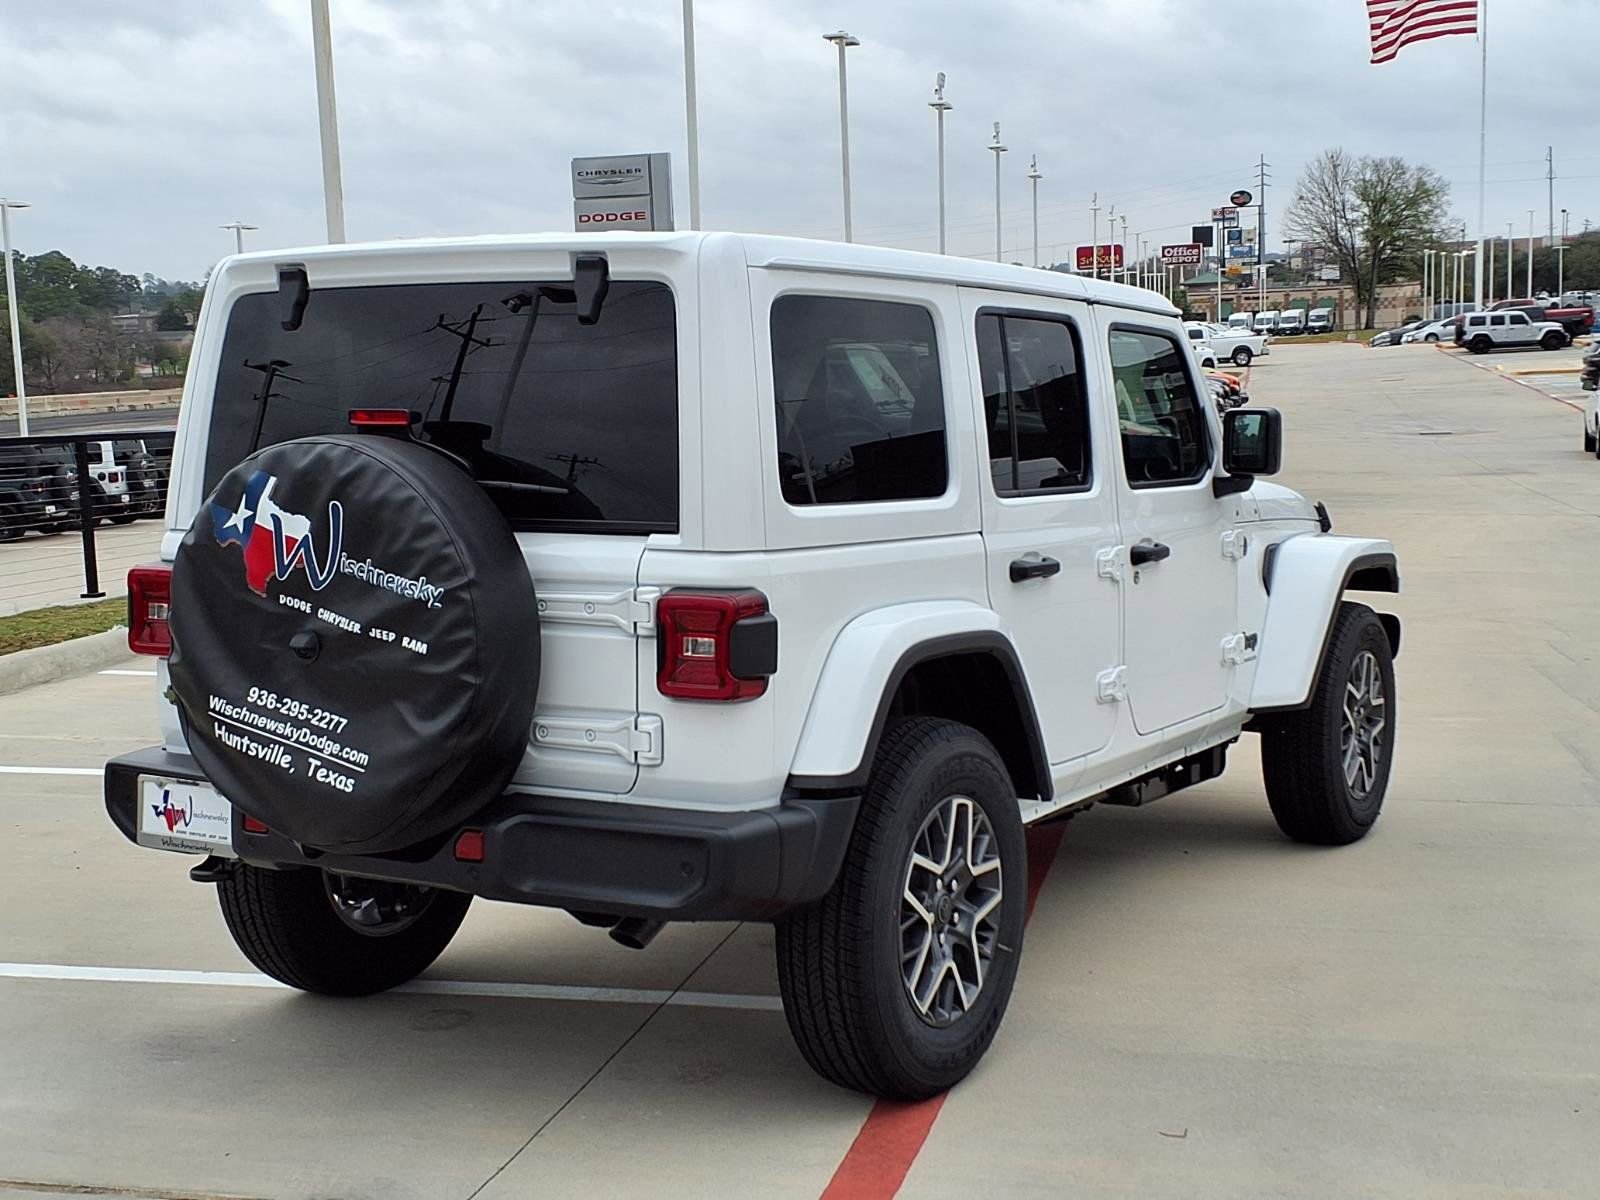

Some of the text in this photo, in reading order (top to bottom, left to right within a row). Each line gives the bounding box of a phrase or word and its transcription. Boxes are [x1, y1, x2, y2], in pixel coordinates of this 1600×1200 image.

[577, 168, 642, 177] CHRYSLER
[578, 211, 647, 223] DODGE
[1164, 246, 1199, 257] Office
[279, 594, 428, 655] DODGE CHRYSLER JEEP RAM
[208, 694, 369, 767] WischnewskyDodge.com
[247, 686, 348, 734] 936-295-2277
[214, 722, 355, 793] Huntsville, Texas
